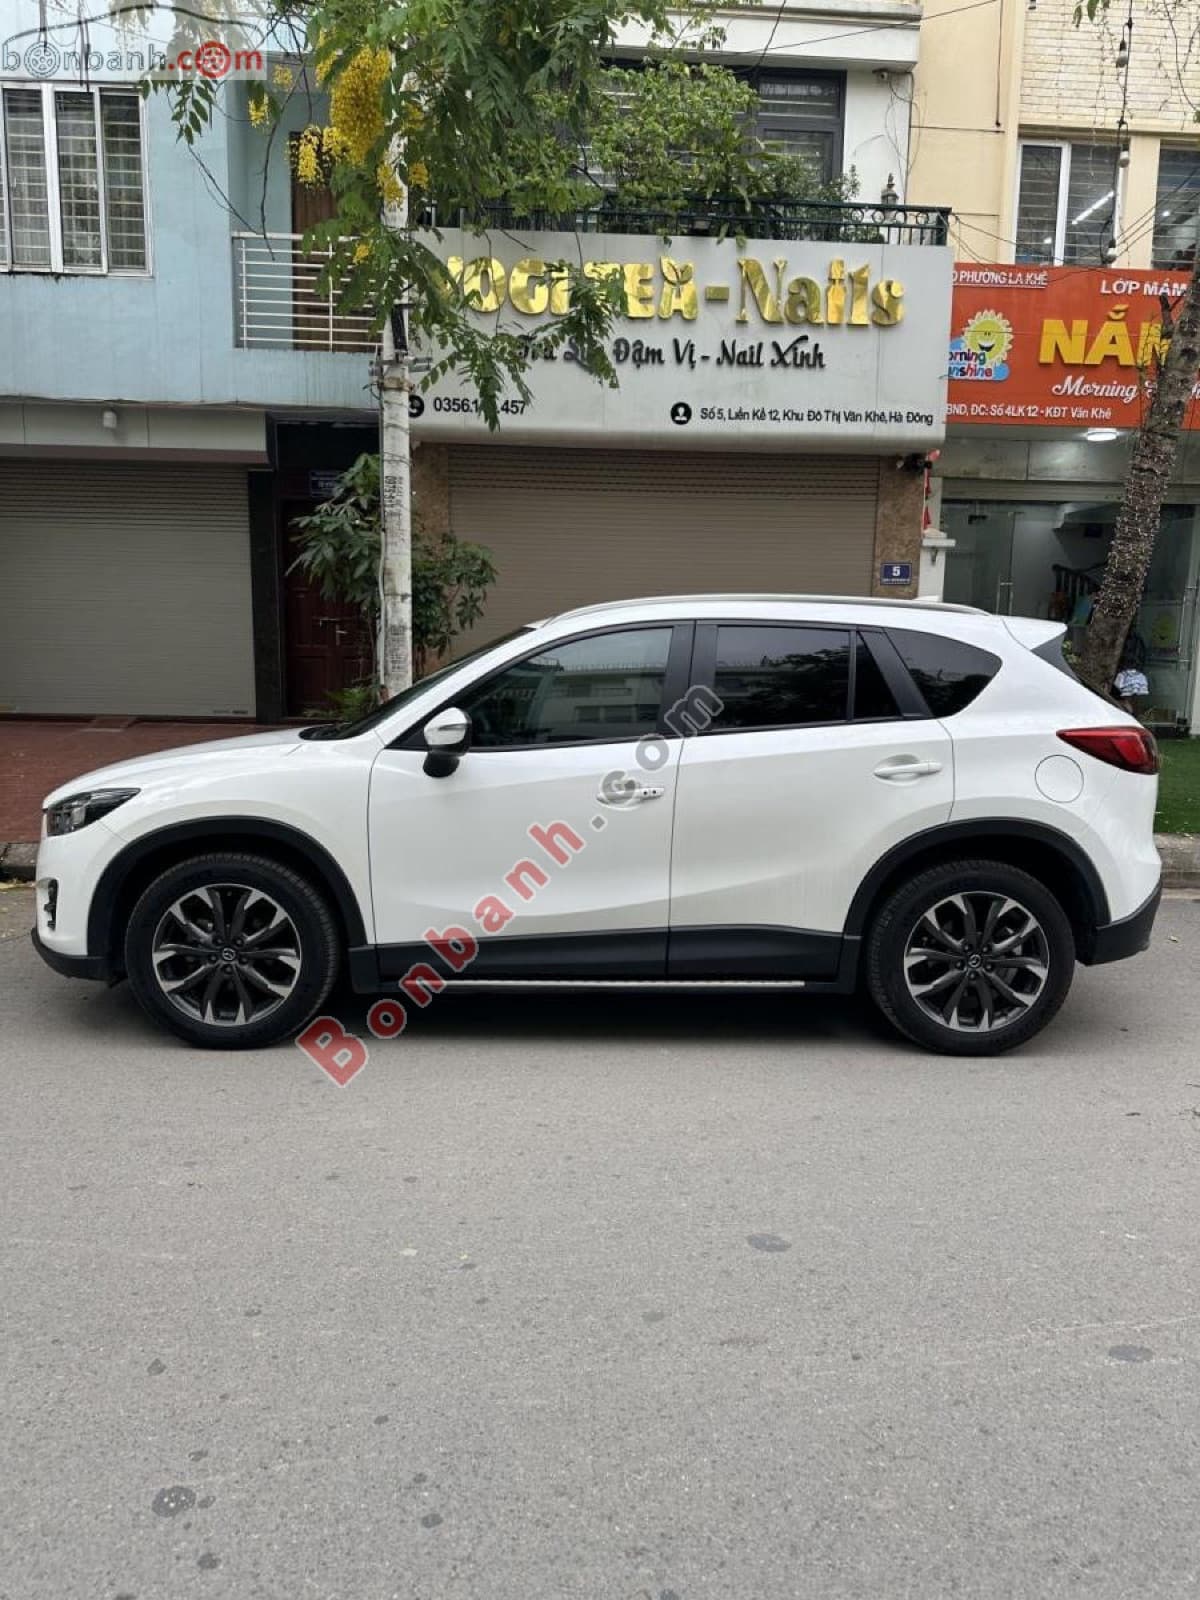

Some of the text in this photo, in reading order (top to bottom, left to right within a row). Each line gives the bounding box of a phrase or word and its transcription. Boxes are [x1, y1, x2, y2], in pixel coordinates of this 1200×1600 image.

[736, 257, 904, 326] Nails
[1100, 277, 1140, 295] LỚP
[1039, 303, 1172, 367] NẮN
[613, 337, 665, 369] Đậm
[673, 337, 696, 370] Vị
[716, 338, 764, 367] Nail
[1052, 375, 1138, 404] Morning
[433, 396, 526, 415] 0356.1.457
[700, 405, 716, 420] Số
[783, 409, 804, 422] Khu
[824, 409, 841, 424] Thị
[906, 411, 934, 426] Đông
[990, 403, 1004, 417] Số
[1027, 405, 1039, 417] 12
[1091, 407, 1112, 420] Khê
[892, 566, 901, 577] 5
